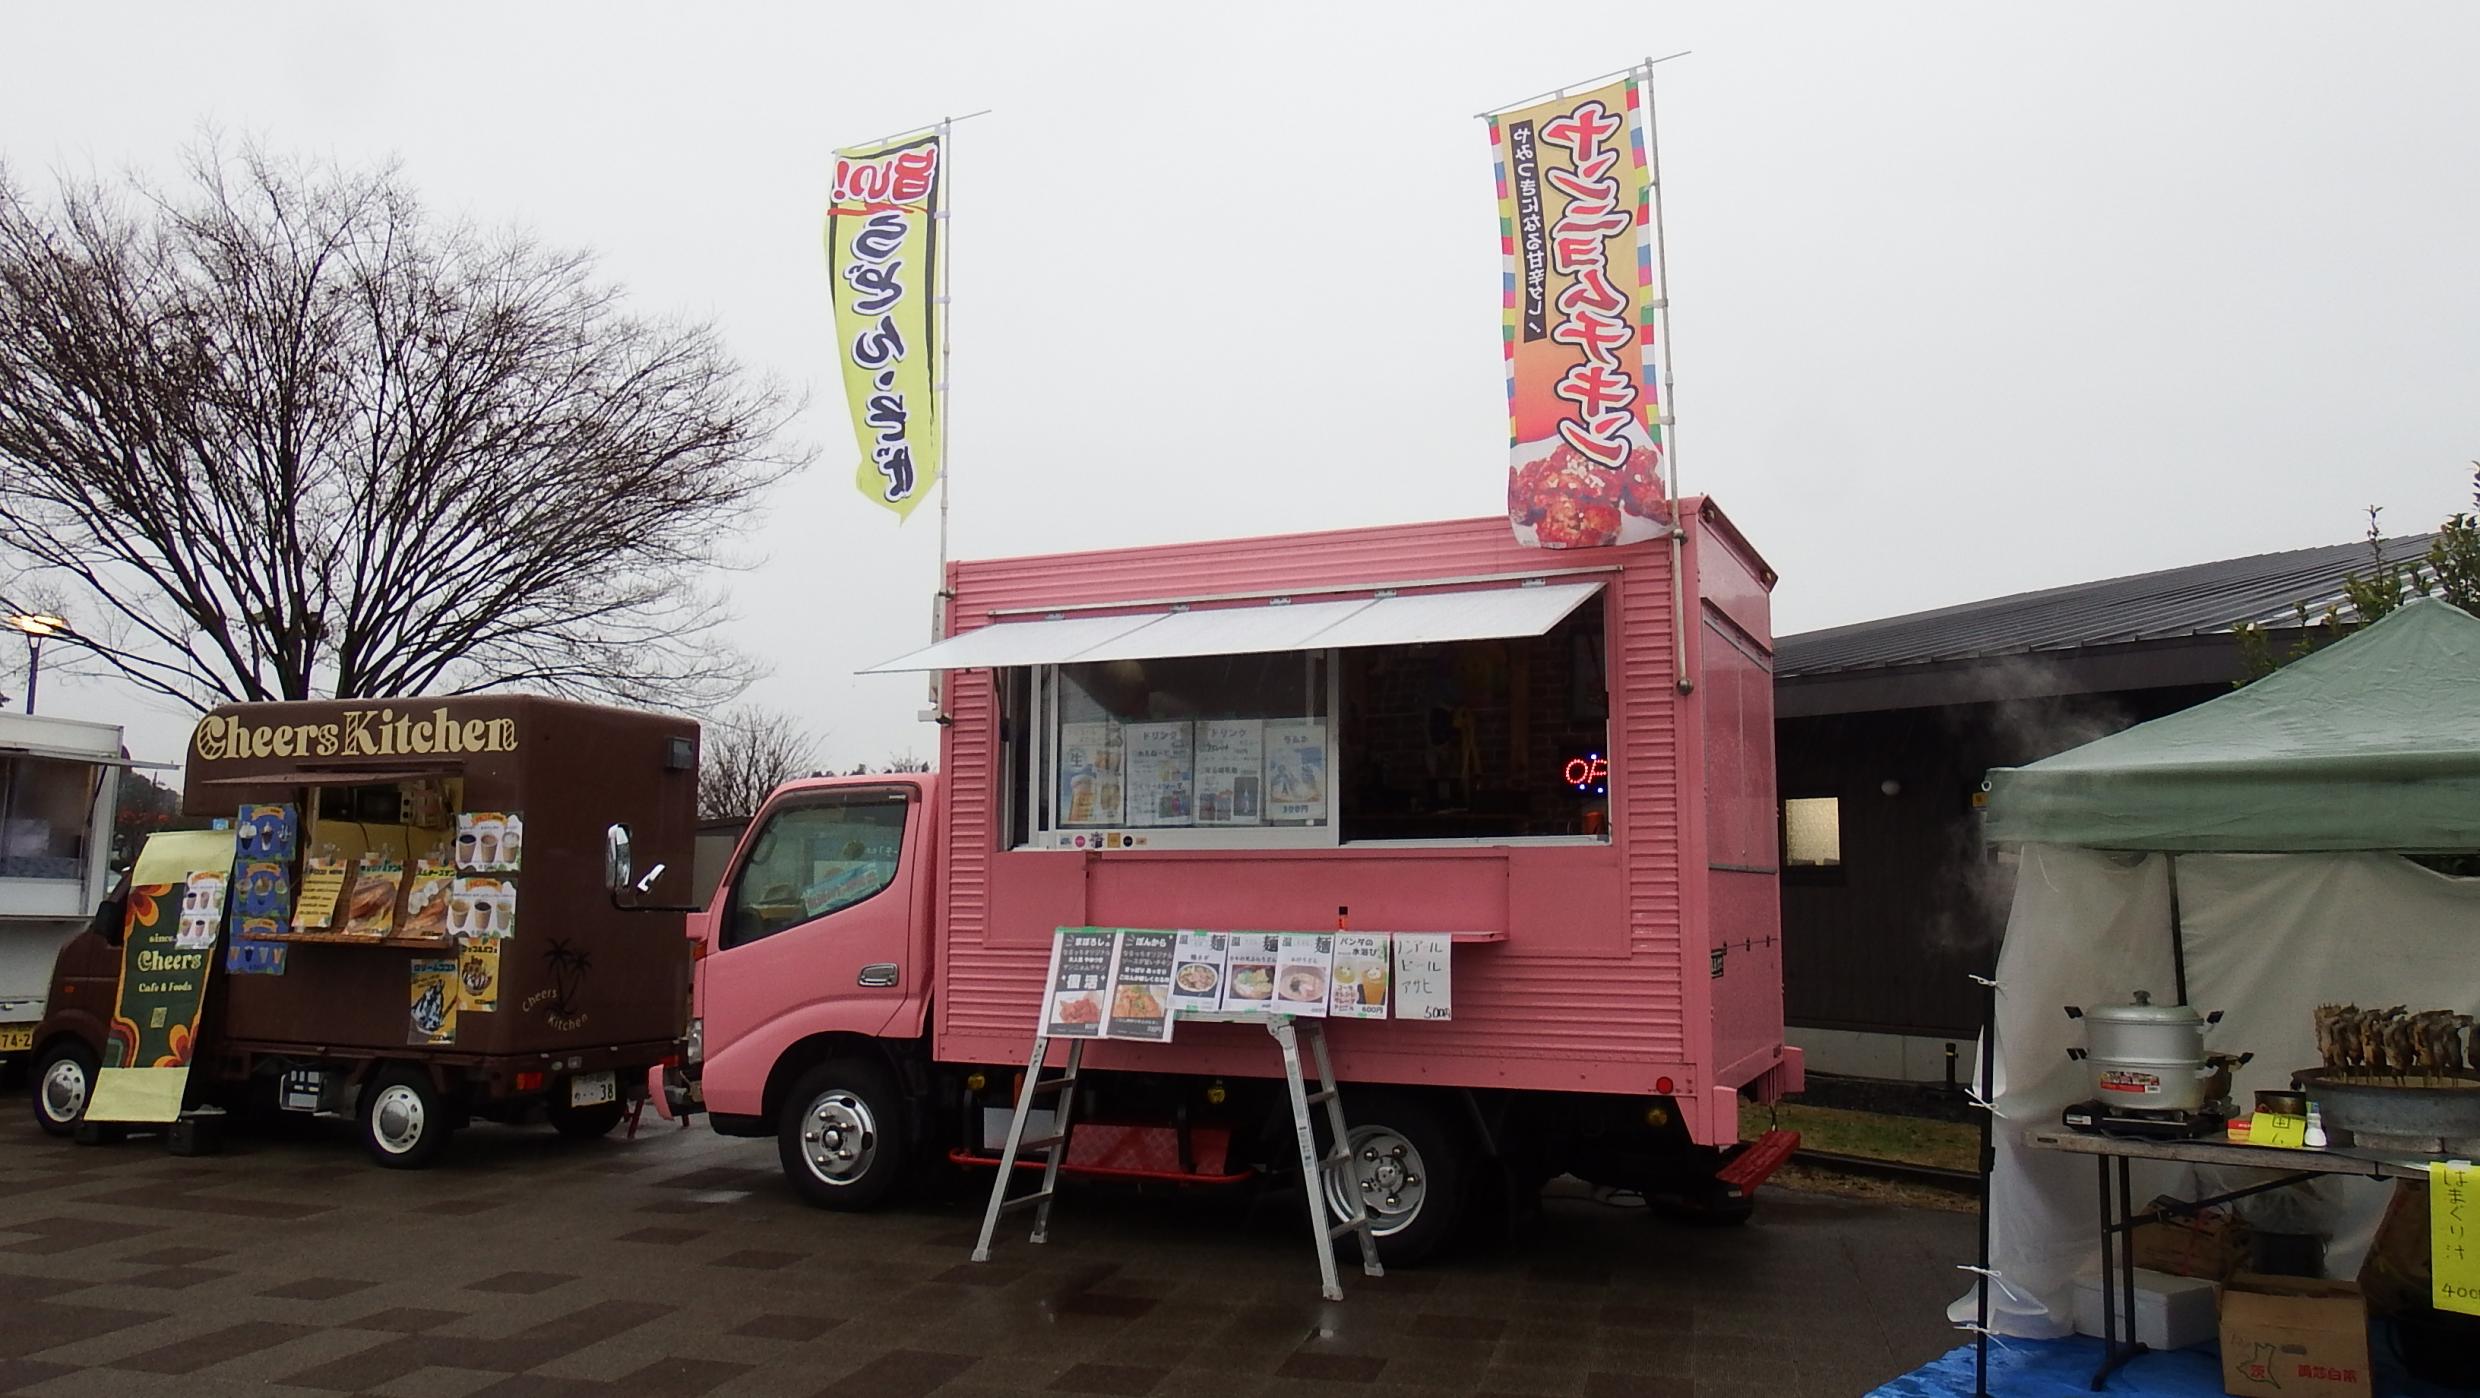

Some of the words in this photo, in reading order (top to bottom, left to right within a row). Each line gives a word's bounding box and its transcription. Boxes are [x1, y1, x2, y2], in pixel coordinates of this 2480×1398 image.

[197, 715, 339, 760] Cheers
[342, 707, 519, 756] Kitchen
[137, 950, 202, 972] Cheers
[1401, 959, 1442, 972] ビール
[138, 982, 159, 993] Cafe
[168, 981, 192, 991] Foods
[1401, 978, 1433, 994] アサヒ
[2443, 1170, 2469, 1261] はまぐり汁
